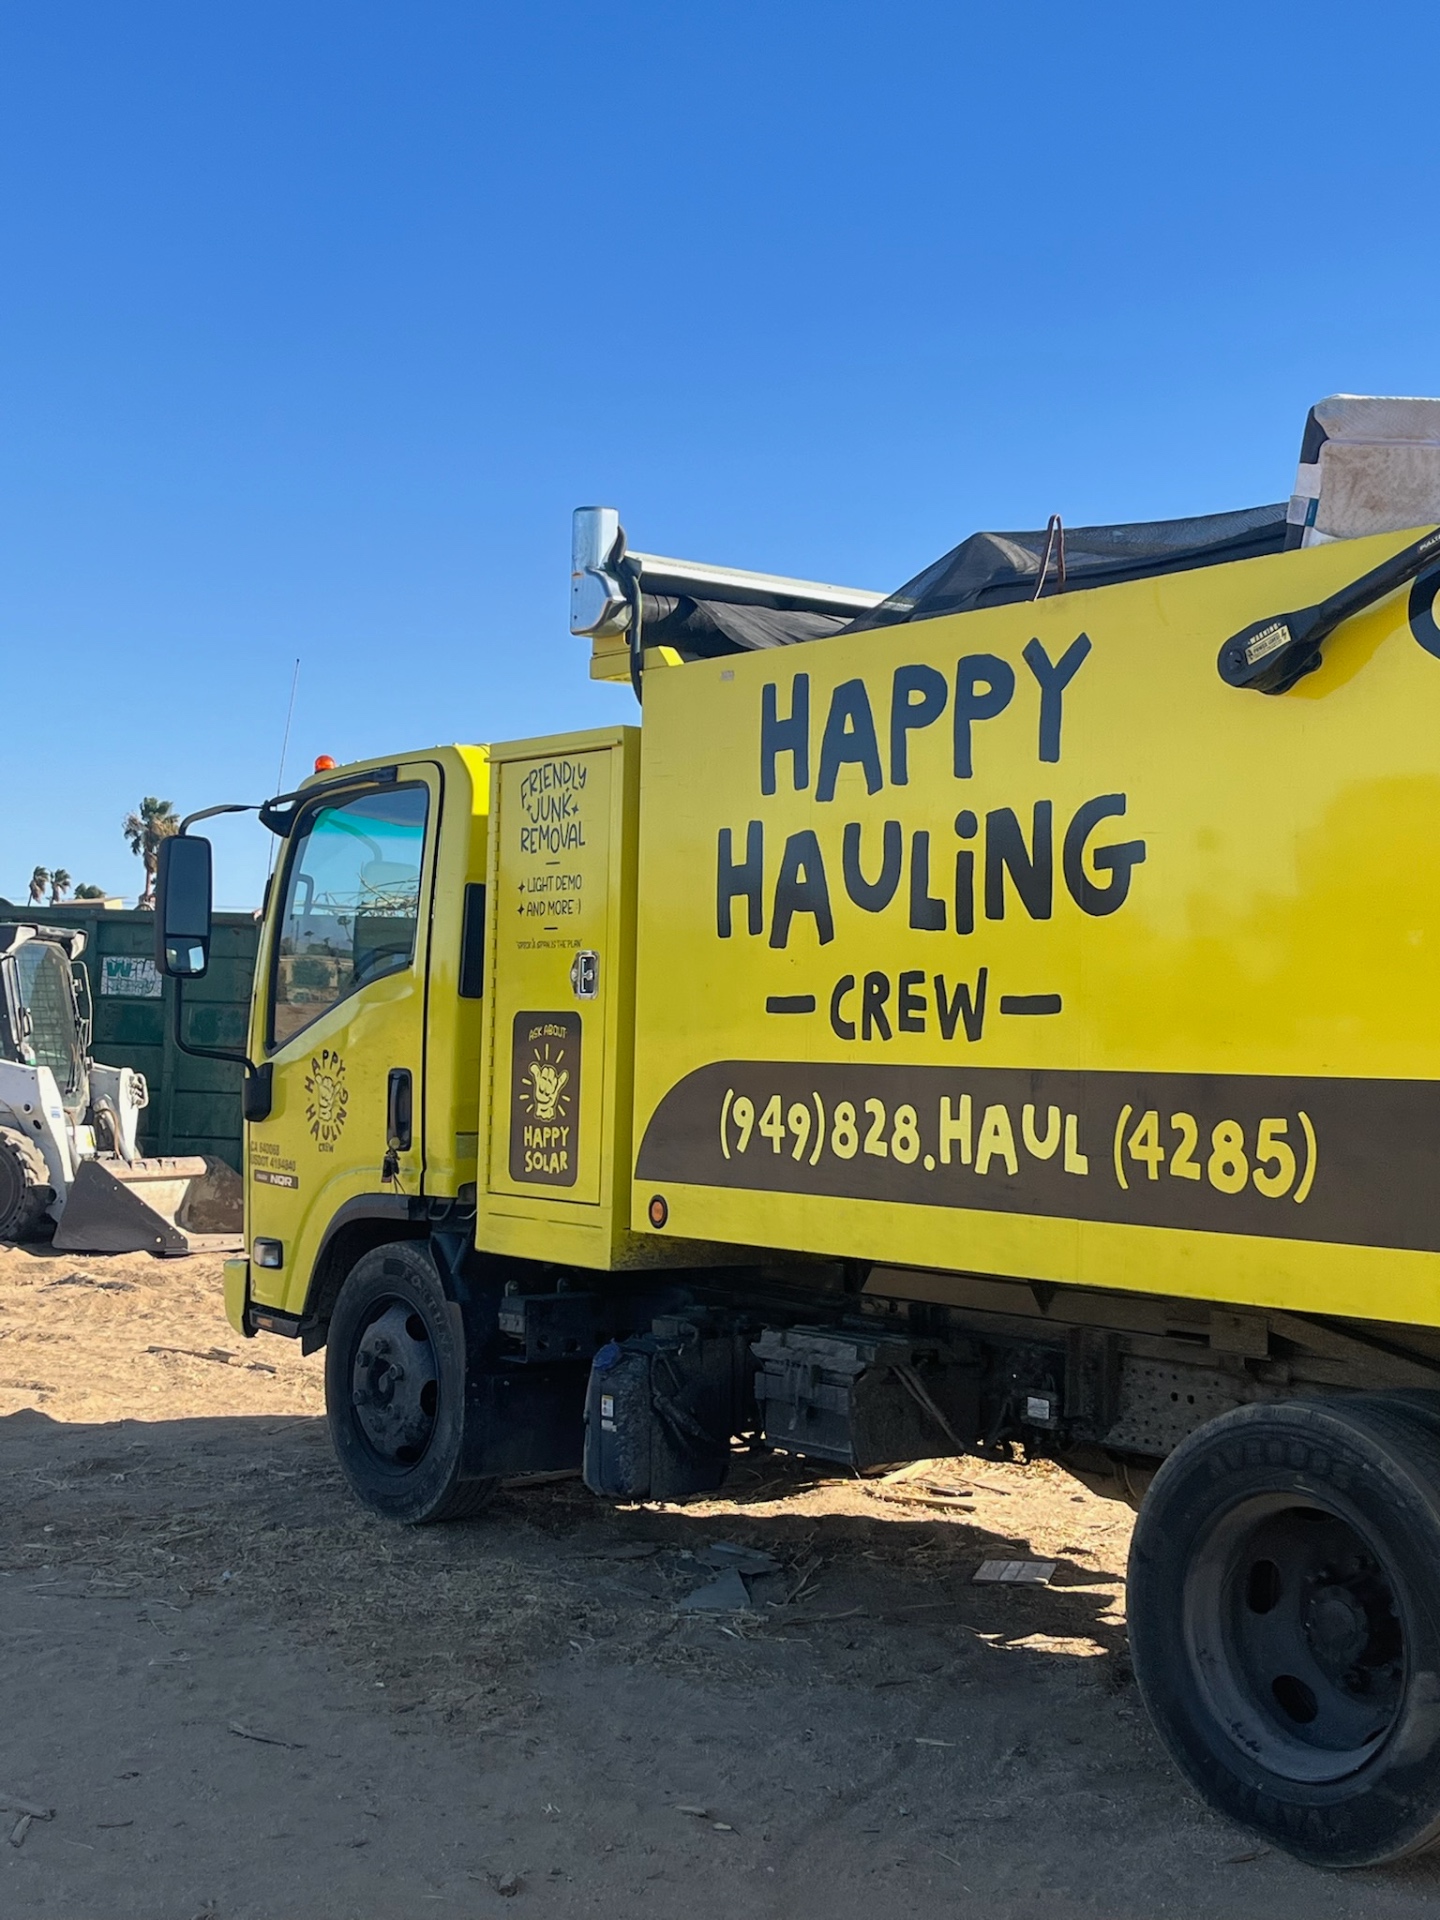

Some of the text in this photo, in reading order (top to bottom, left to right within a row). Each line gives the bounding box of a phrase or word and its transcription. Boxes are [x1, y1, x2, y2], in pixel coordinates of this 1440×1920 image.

[761, 632, 1092, 802] HAPPY
[521, 761, 587, 809] FRIENDLY
[530, 790, 573, 824] JUNK
[520, 821, 586, 854] REMOVAL
[527, 874, 582, 893] LIGHT DEMO
[526, 901, 545, 917] AND
[548, 899, 574, 916] MORE
[829, 966, 988, 1042] CREW
[528, 1024, 567, 1042] ASK ABOUT
[304, 1049, 346, 1093] HAPPY
[318, 1142, 334, 1153] CREW
[524, 1125, 570, 1149] HAPPY
[524, 1150, 568, 1174] SOLAR
[1113, 1104, 1318, 1204] (4285)
[270, 1174, 293, 1187] NQR
